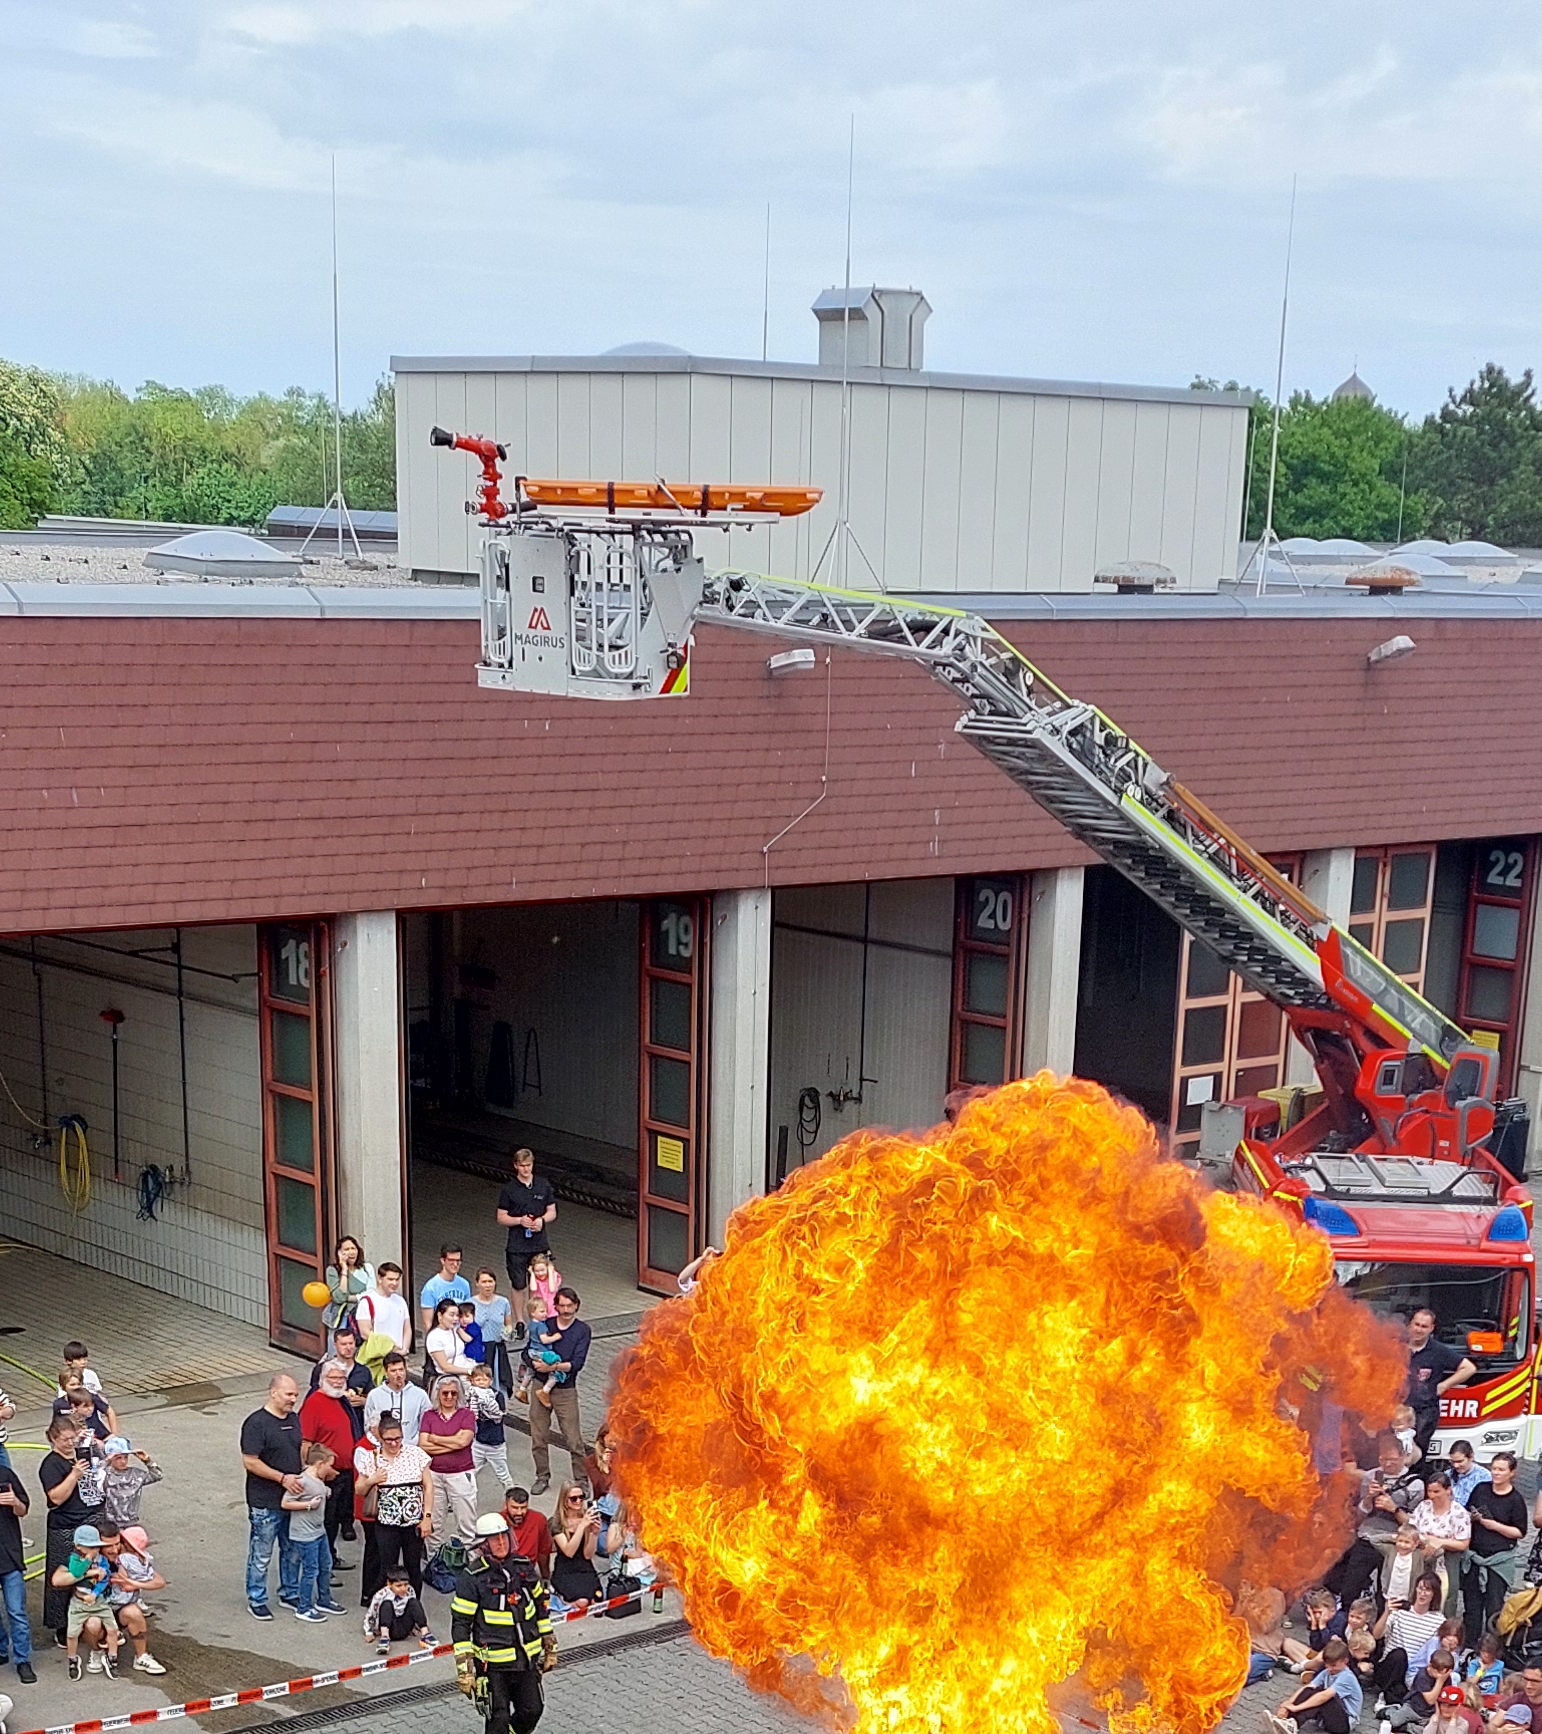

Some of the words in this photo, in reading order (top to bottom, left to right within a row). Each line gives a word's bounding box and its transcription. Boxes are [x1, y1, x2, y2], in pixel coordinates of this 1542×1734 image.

[514, 631, 565, 649] MAGIRUS
[1486, 849, 1524, 888] 22
[977, 888, 1013, 931] 20
[660, 911, 694, 958] 19
[1439, 1398, 1479, 1419] EHR
